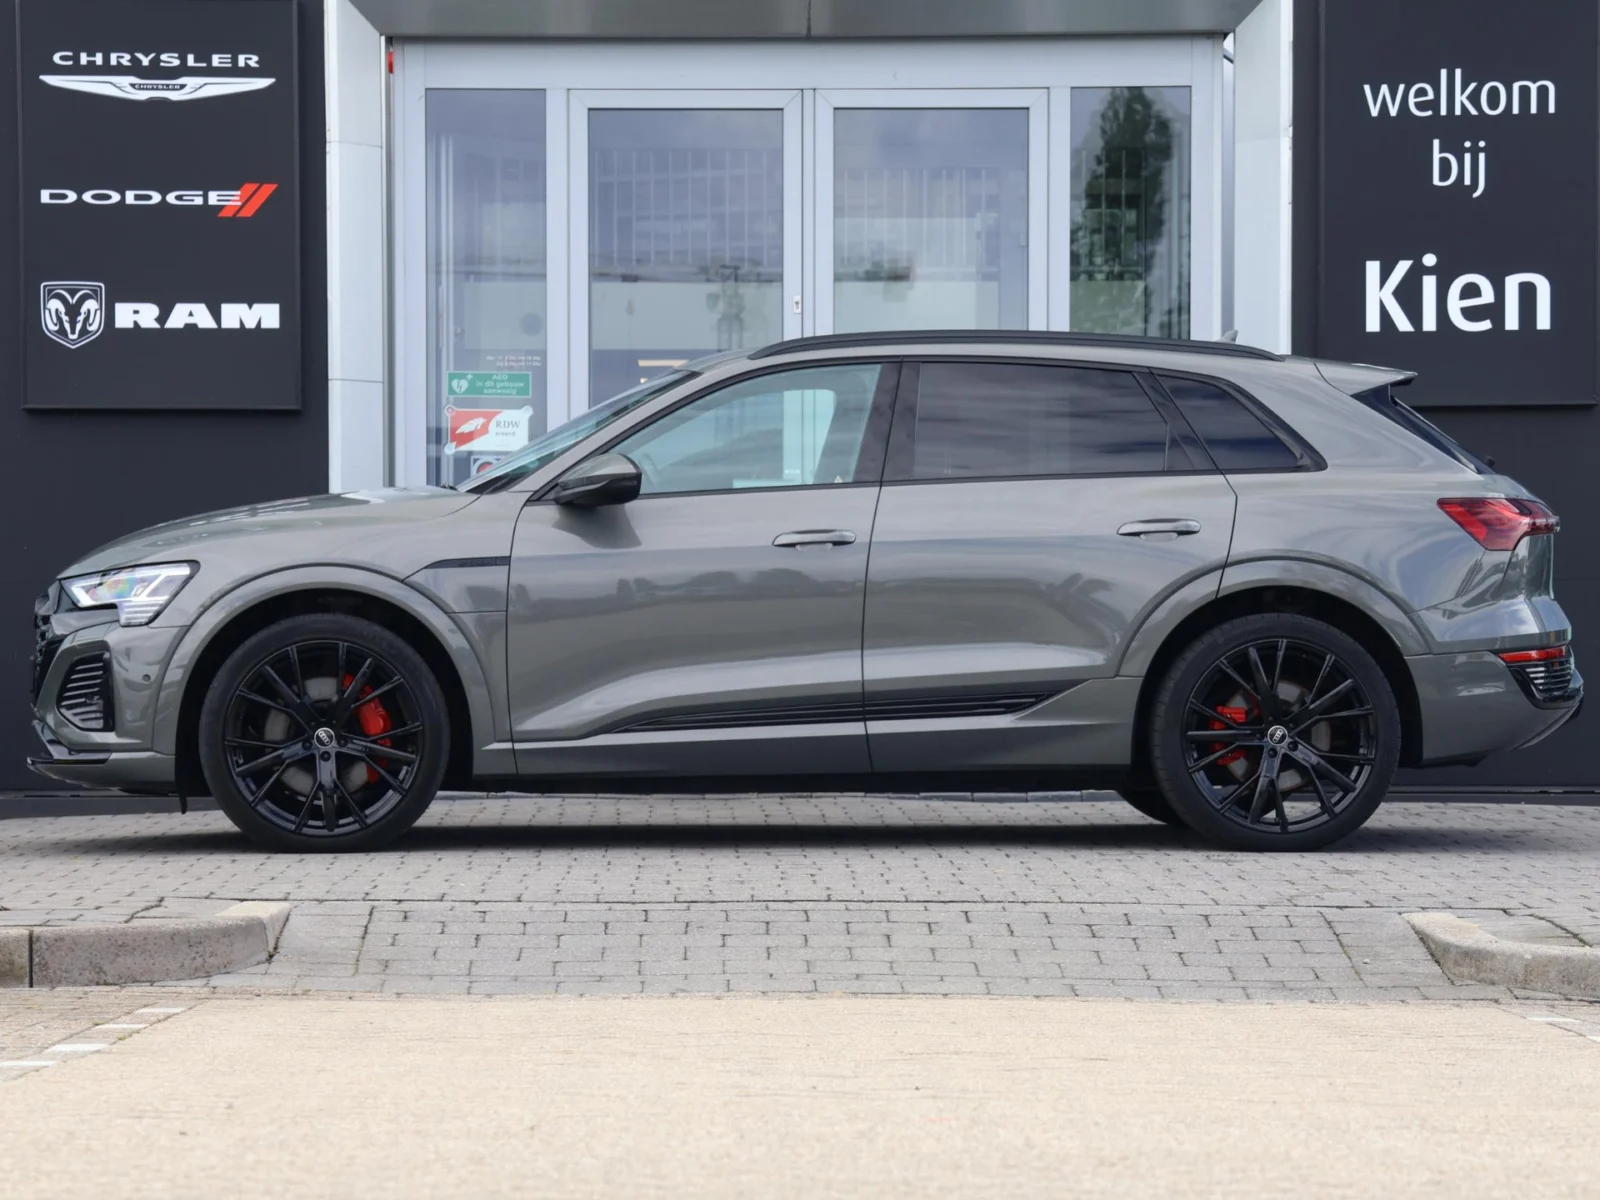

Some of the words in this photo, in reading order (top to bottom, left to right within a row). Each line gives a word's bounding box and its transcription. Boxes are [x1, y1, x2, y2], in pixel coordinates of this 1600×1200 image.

[53, 51, 260, 67] CHRYSLER
[1363, 68, 1556, 117] welkom
[1432, 139, 1486, 198] bij
[40, 189, 242, 205] DODGE
[1365, 253, 1551, 332] Kien
[114, 303, 280, 328] RAM
[496, 420, 520, 429] RDW
